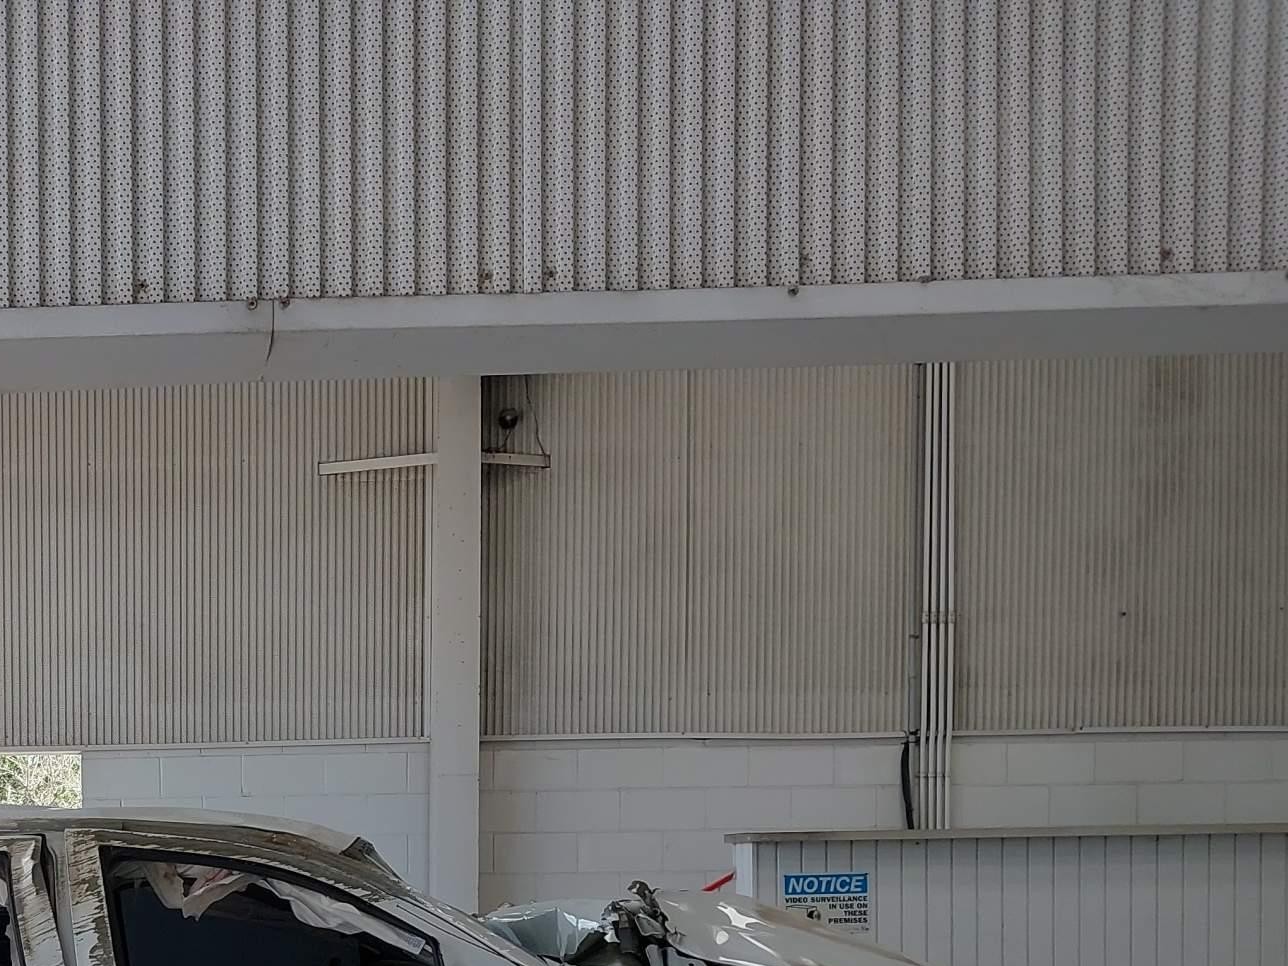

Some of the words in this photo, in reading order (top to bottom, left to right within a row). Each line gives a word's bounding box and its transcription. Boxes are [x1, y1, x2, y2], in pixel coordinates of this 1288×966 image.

[787, 876, 865, 893] NOTICE
[785, 896, 808, 904] VIDEO
[810, 895, 868, 903] SURVEILLANCE
